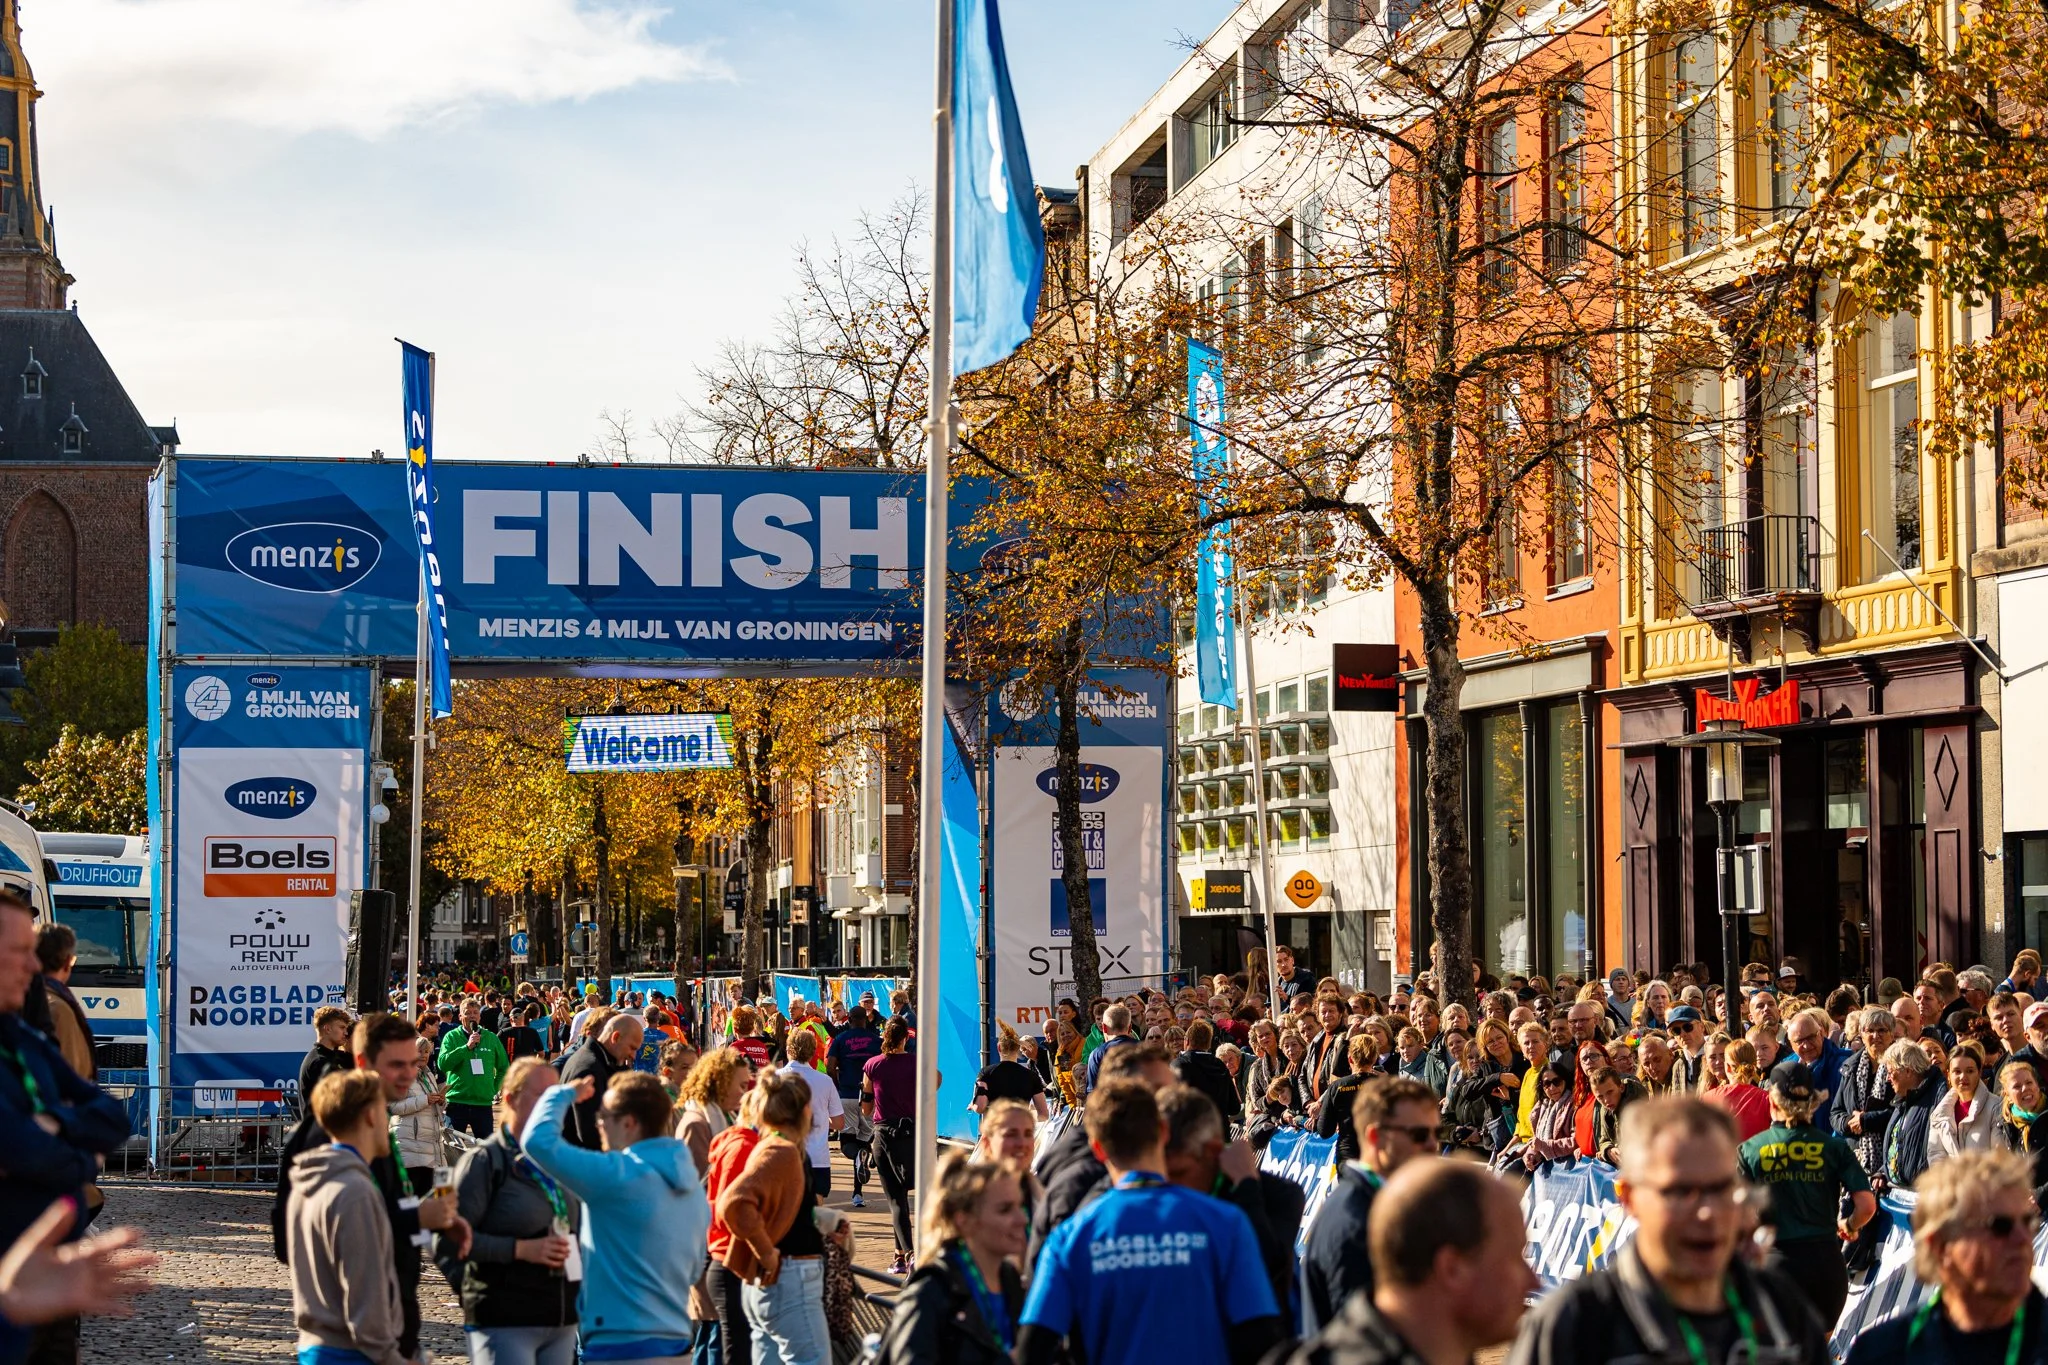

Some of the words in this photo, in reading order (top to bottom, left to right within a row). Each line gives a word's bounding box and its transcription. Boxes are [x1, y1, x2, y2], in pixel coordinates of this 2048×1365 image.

[462, 489, 909, 590] FINISH
[251, 538, 360, 573] menzis
[479, 618, 580, 638] MENZIS
[585, 619, 602, 638] 4
[608, 619, 669, 639] MIJL
[675, 620, 731, 640] VAN
[736, 621, 893, 641] GRONINGEN
[251, 676, 277, 684] menzis
[245, 690, 258, 704] 4
[262, 691, 306, 704] MIJL
[310, 691, 350, 705] VAN
[245, 705, 360, 718] GRONINGEN
[1049, 771, 1109, 792] mnzis
[238, 785, 305, 807] menzis
[211, 843, 330, 868] Boels
[61, 867, 138, 884] DRIJFHOUT
[287, 878, 329, 891] RENTAL
[1210, 885, 1241, 893] xenos
[230, 934, 310, 948] POUW
[242, 951, 298, 962] RENT
[1028, 945, 1131, 976] STX
[190, 985, 324, 1004] DAGBLAD
